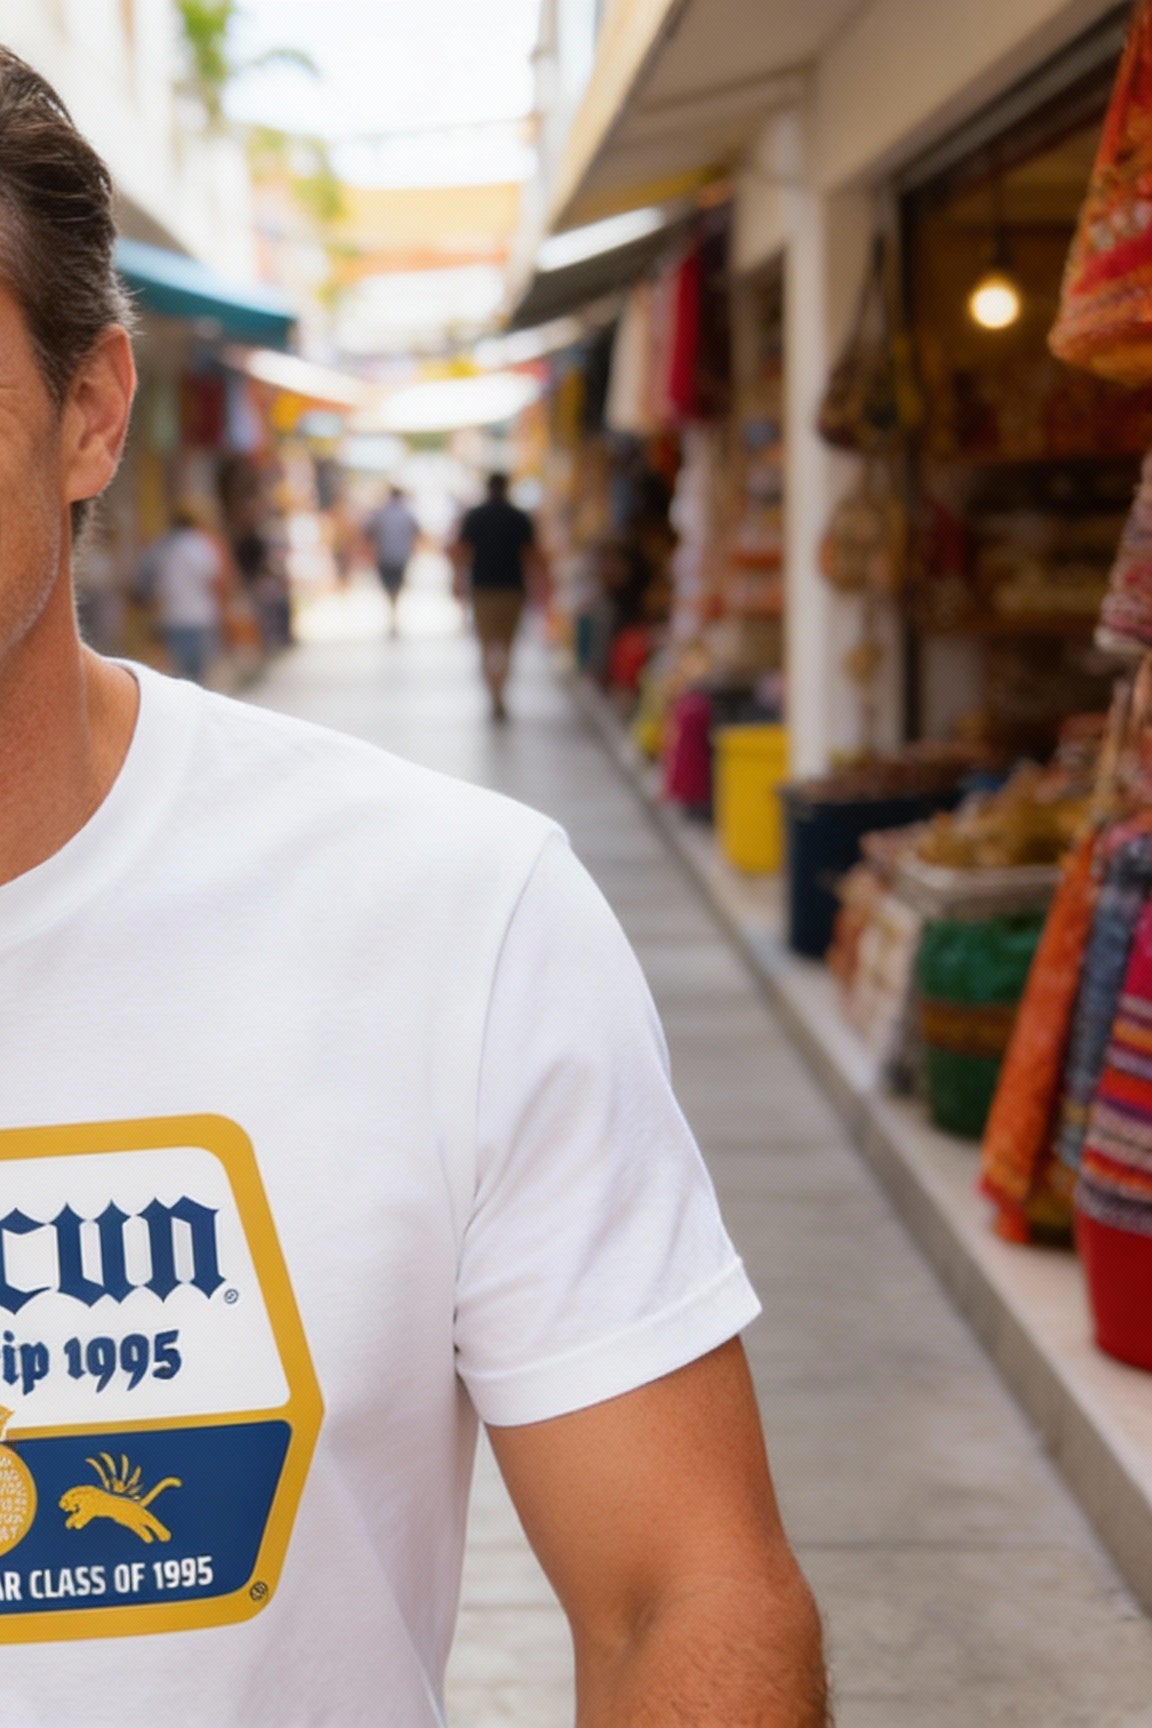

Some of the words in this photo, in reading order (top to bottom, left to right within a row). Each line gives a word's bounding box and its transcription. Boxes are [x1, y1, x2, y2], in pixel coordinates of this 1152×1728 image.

[64, 1329, 183, 1394] 1995
[29, 1564, 107, 1599] CLASS
[114, 1562, 146, 1594] OF
[153, 1555, 214, 1590] 1995
